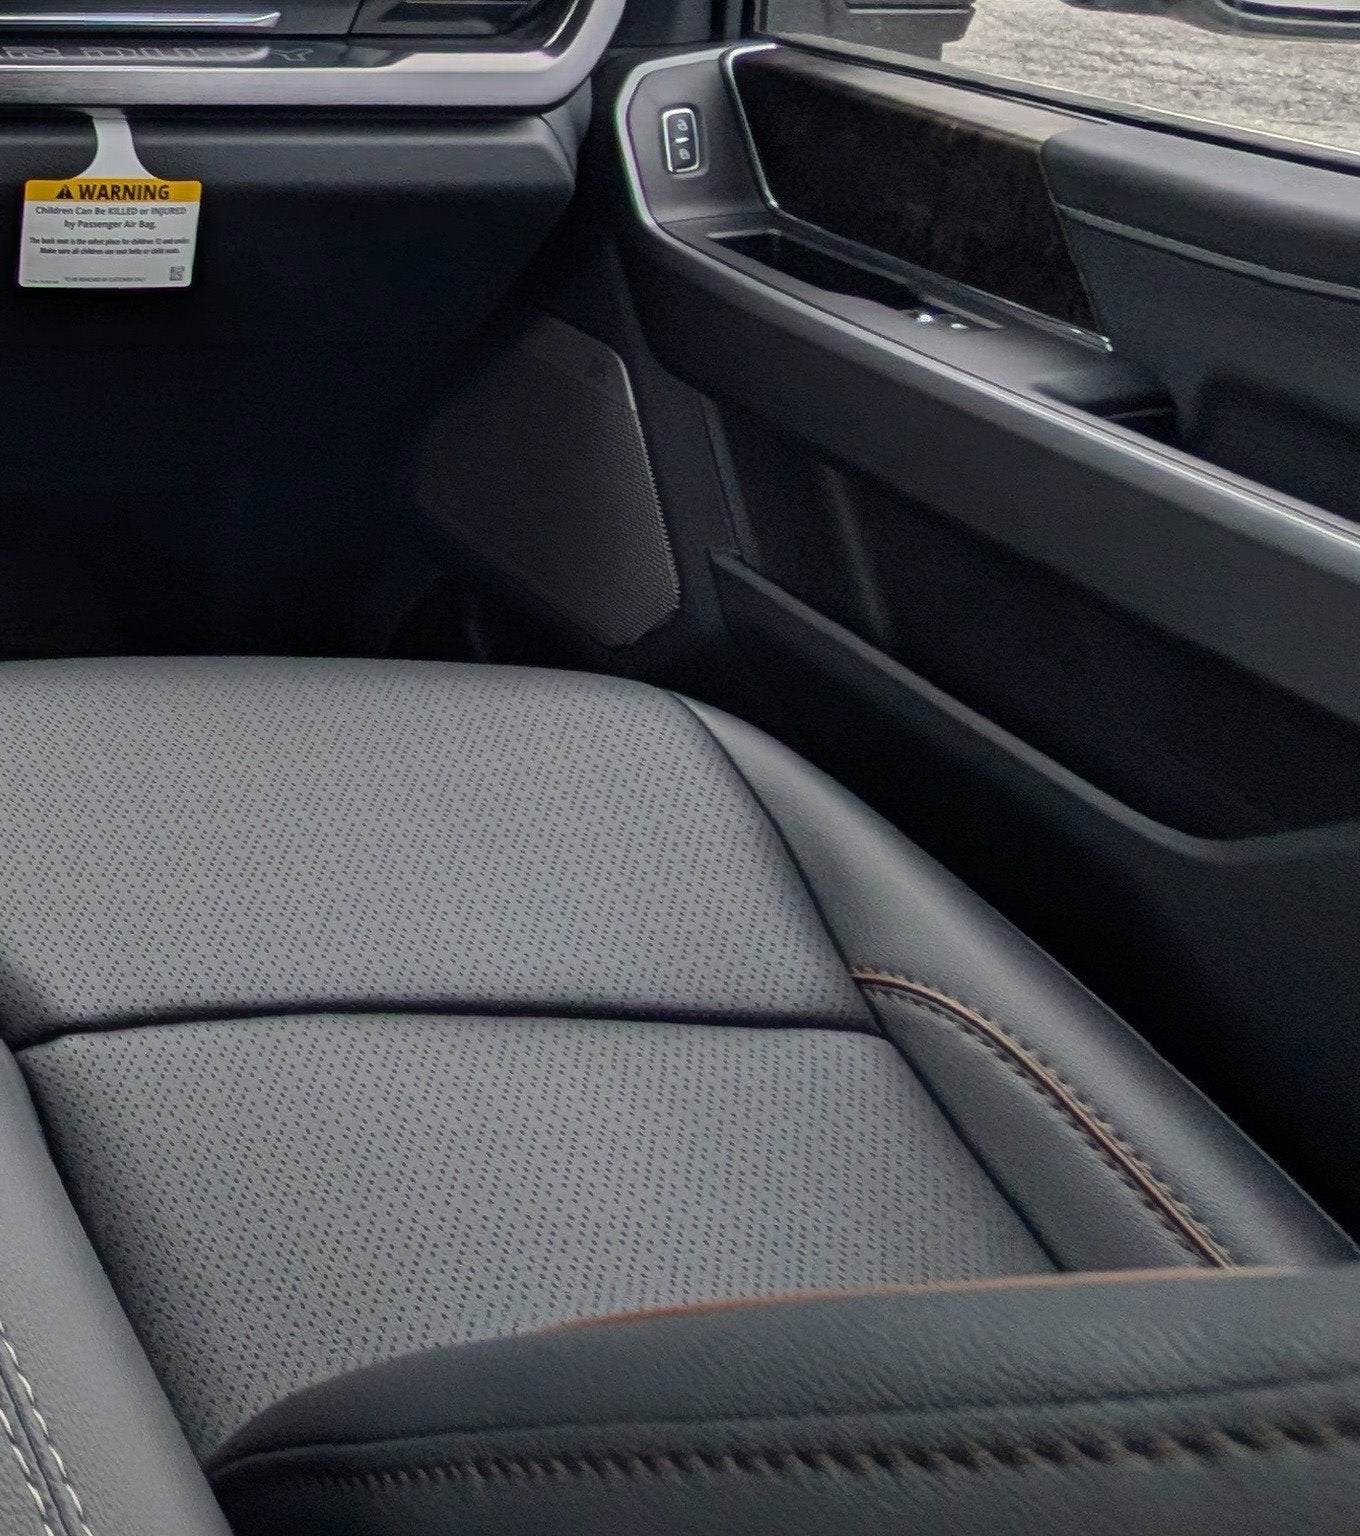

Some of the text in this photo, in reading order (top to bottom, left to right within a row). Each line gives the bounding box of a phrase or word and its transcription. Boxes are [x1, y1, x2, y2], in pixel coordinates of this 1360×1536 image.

[79, 184, 170, 201] WARNING
[35, 206, 74, 216] Children
[75, 207, 93, 216] Can
[95, 207, 106, 215] Be
[108, 207, 138, 215] KILLED
[151, 207, 187, 216] INJURED
[64, 220, 76, 230] by
[78, 220, 124, 231] Passenger
[125, 220, 138, 228] Air
